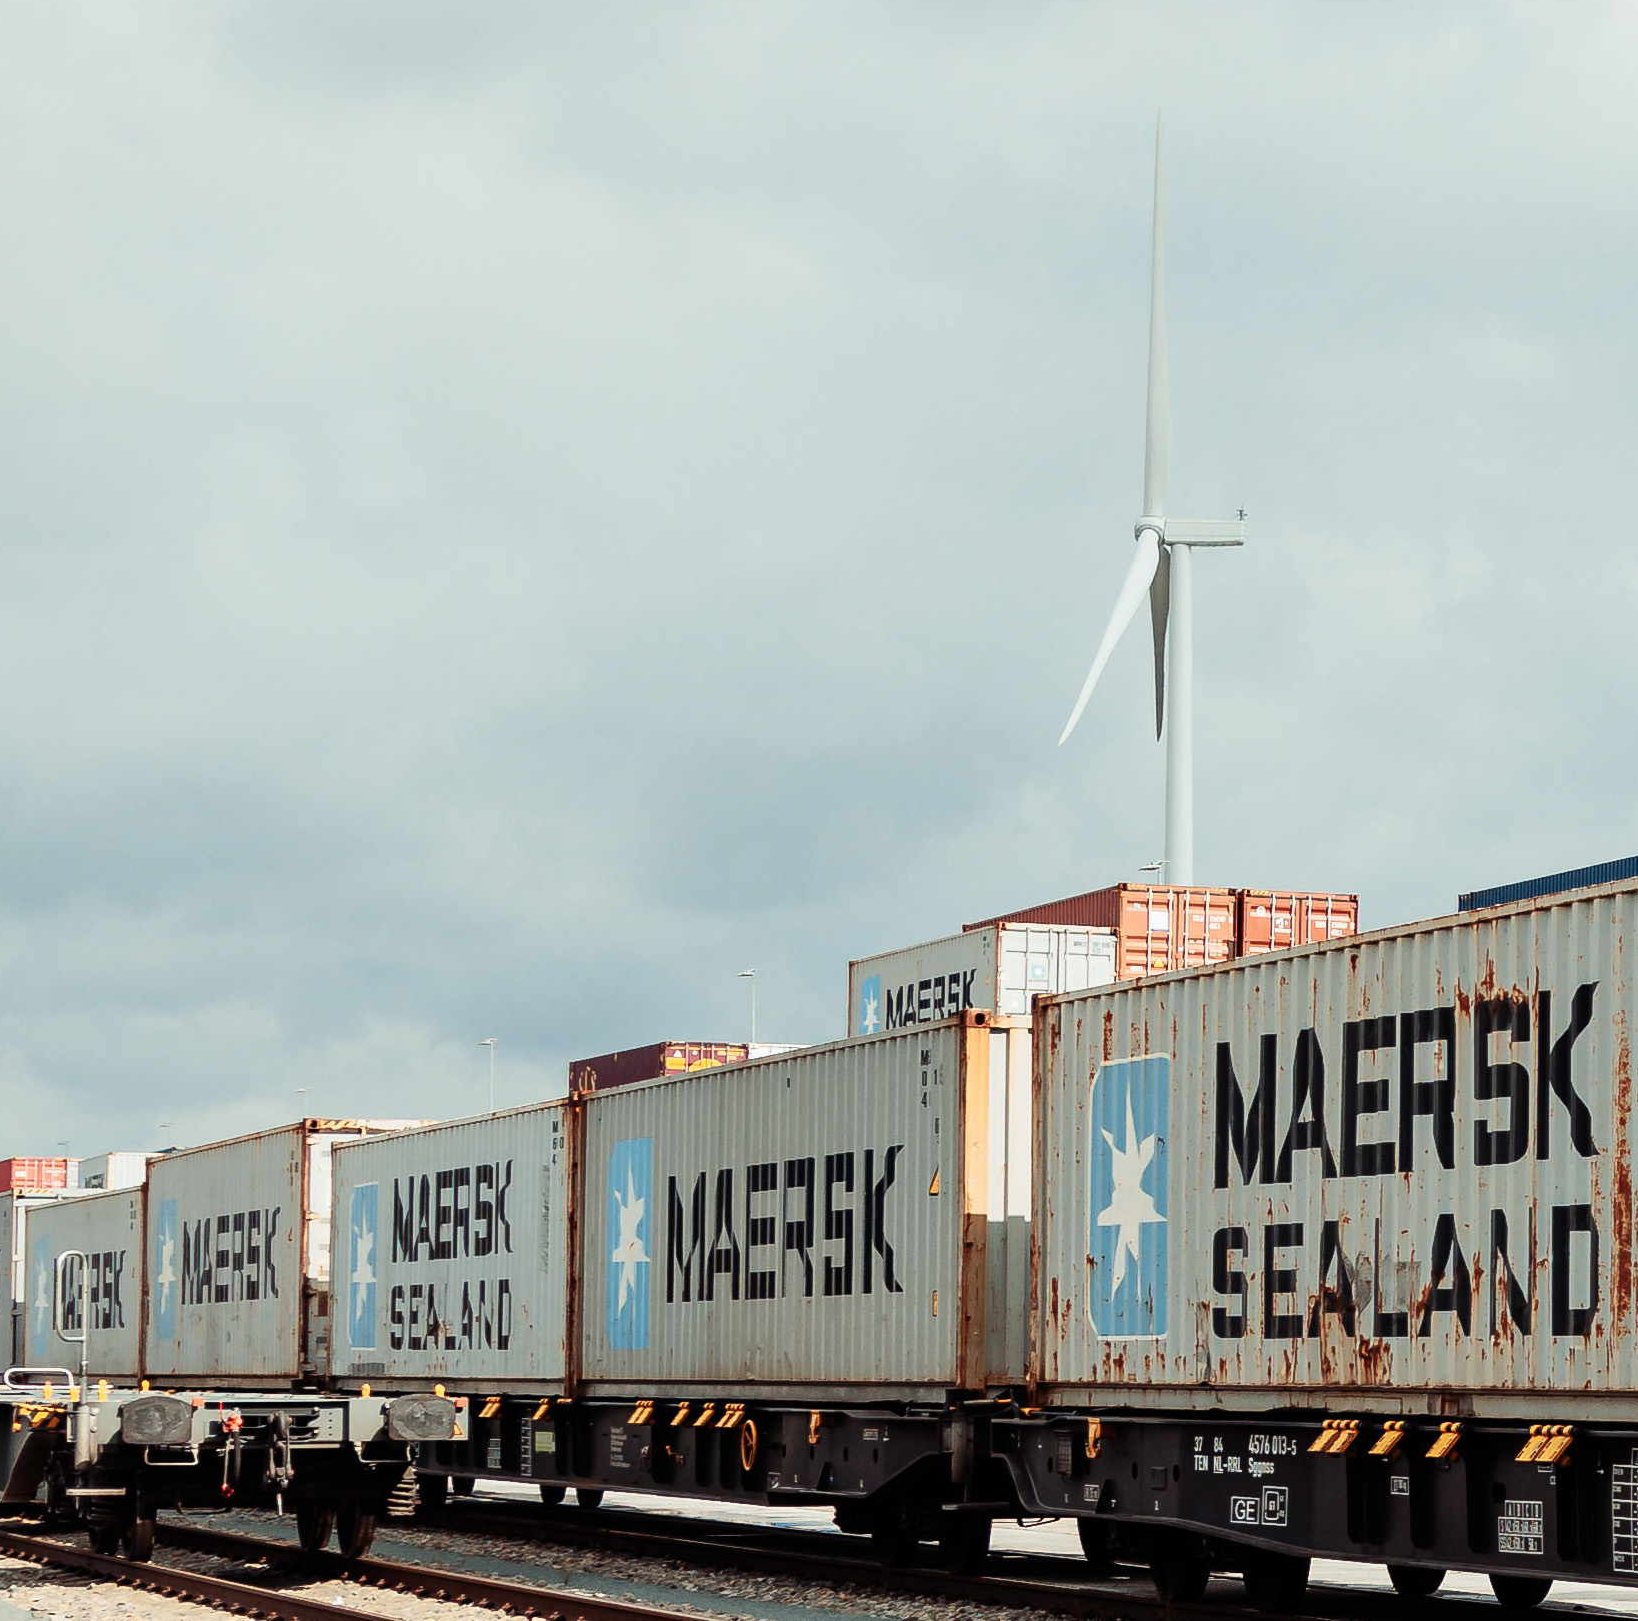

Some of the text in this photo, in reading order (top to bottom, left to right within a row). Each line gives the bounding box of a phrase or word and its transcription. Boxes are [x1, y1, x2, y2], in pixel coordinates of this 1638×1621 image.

[886, 968, 977, 1030] MAERSK
[1214, 980, 1601, 1189] MAERSK
[391, 1159, 513, 1264] MAERSK
[666, 1144, 905, 1304] MAERSK
[181, 1206, 281, 1305] MAERSK
[1212, 1204, 1600, 1339] SEALAND
[390, 1279, 512, 1351] SEALAND
[1194, 1436, 1203, 1452] 37
[1214, 1436, 1223, 1453] 84
[1194, 1455, 1209, 1471] TEN
[1235, 1499, 1256, 1521] GE
